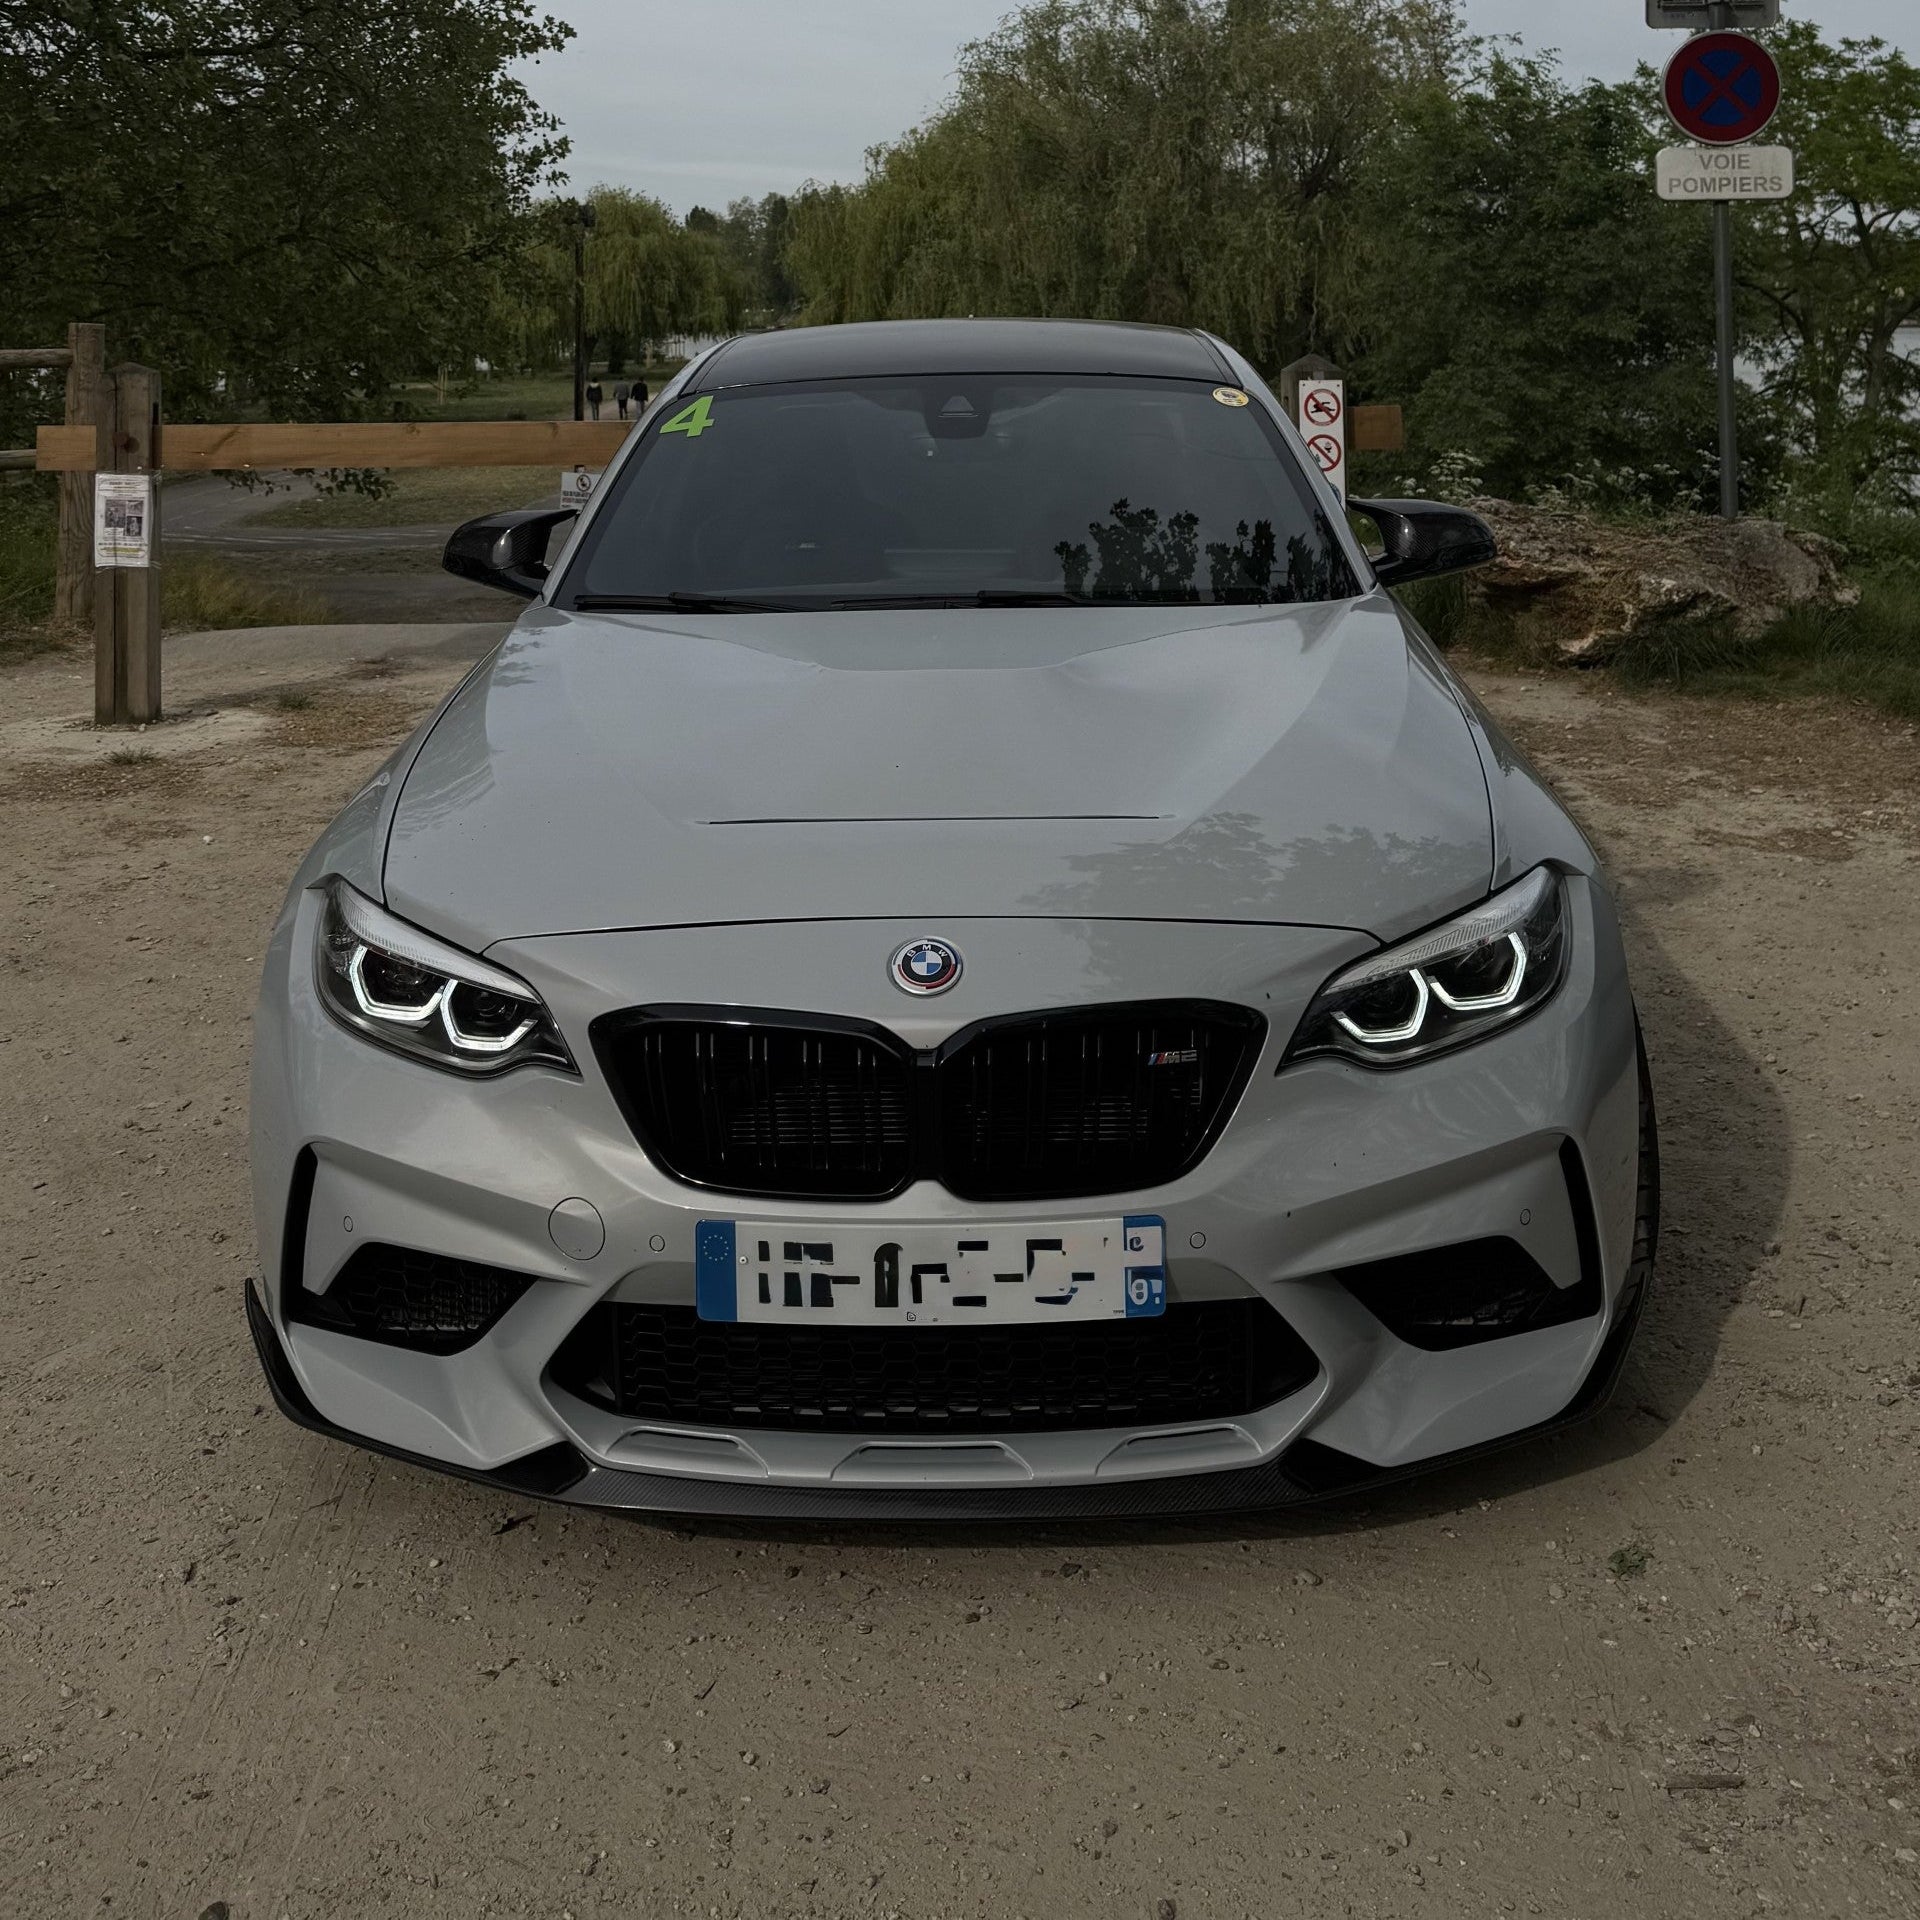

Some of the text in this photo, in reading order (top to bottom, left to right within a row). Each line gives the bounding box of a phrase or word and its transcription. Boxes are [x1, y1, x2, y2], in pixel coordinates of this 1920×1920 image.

[1699, 154, 1750, 170] VOIE
[1669, 176, 1782, 193] POMPIERS
[659, 395, 715, 437] 4
[906, 944, 948, 957] BMW
